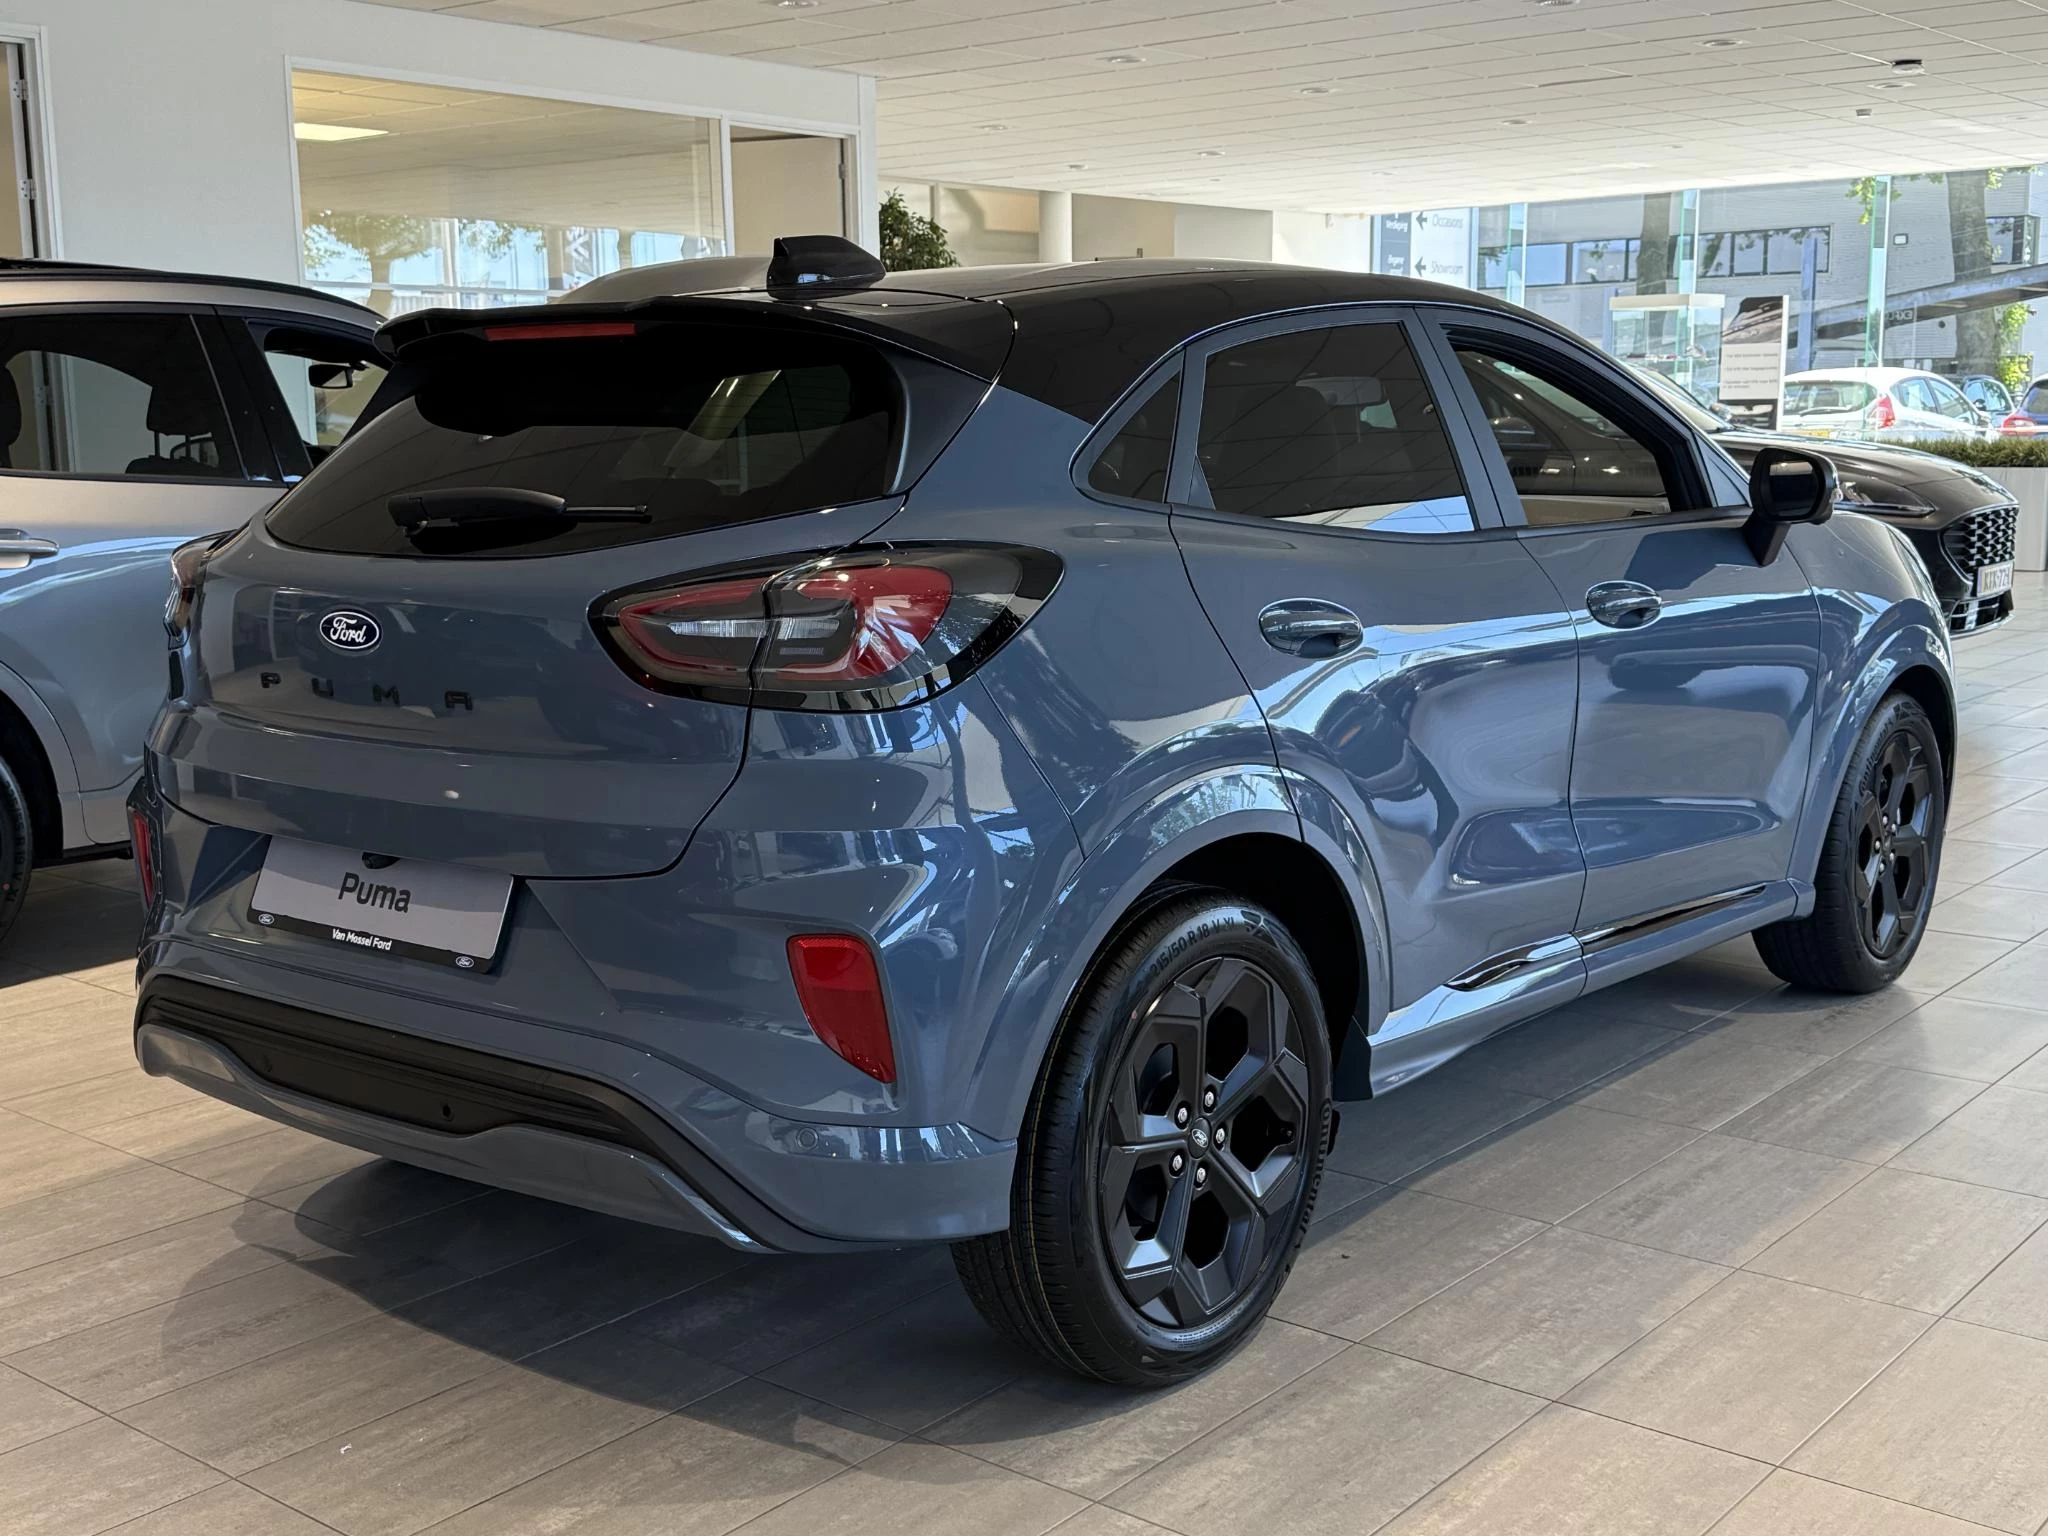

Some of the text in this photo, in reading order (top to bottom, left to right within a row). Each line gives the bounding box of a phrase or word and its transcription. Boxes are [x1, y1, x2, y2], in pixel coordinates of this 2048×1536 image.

[260, 672, 473, 711] PUMA
[338, 872, 411, 913] Puma
[332, 928, 393, 951] Van Mossel Ford
